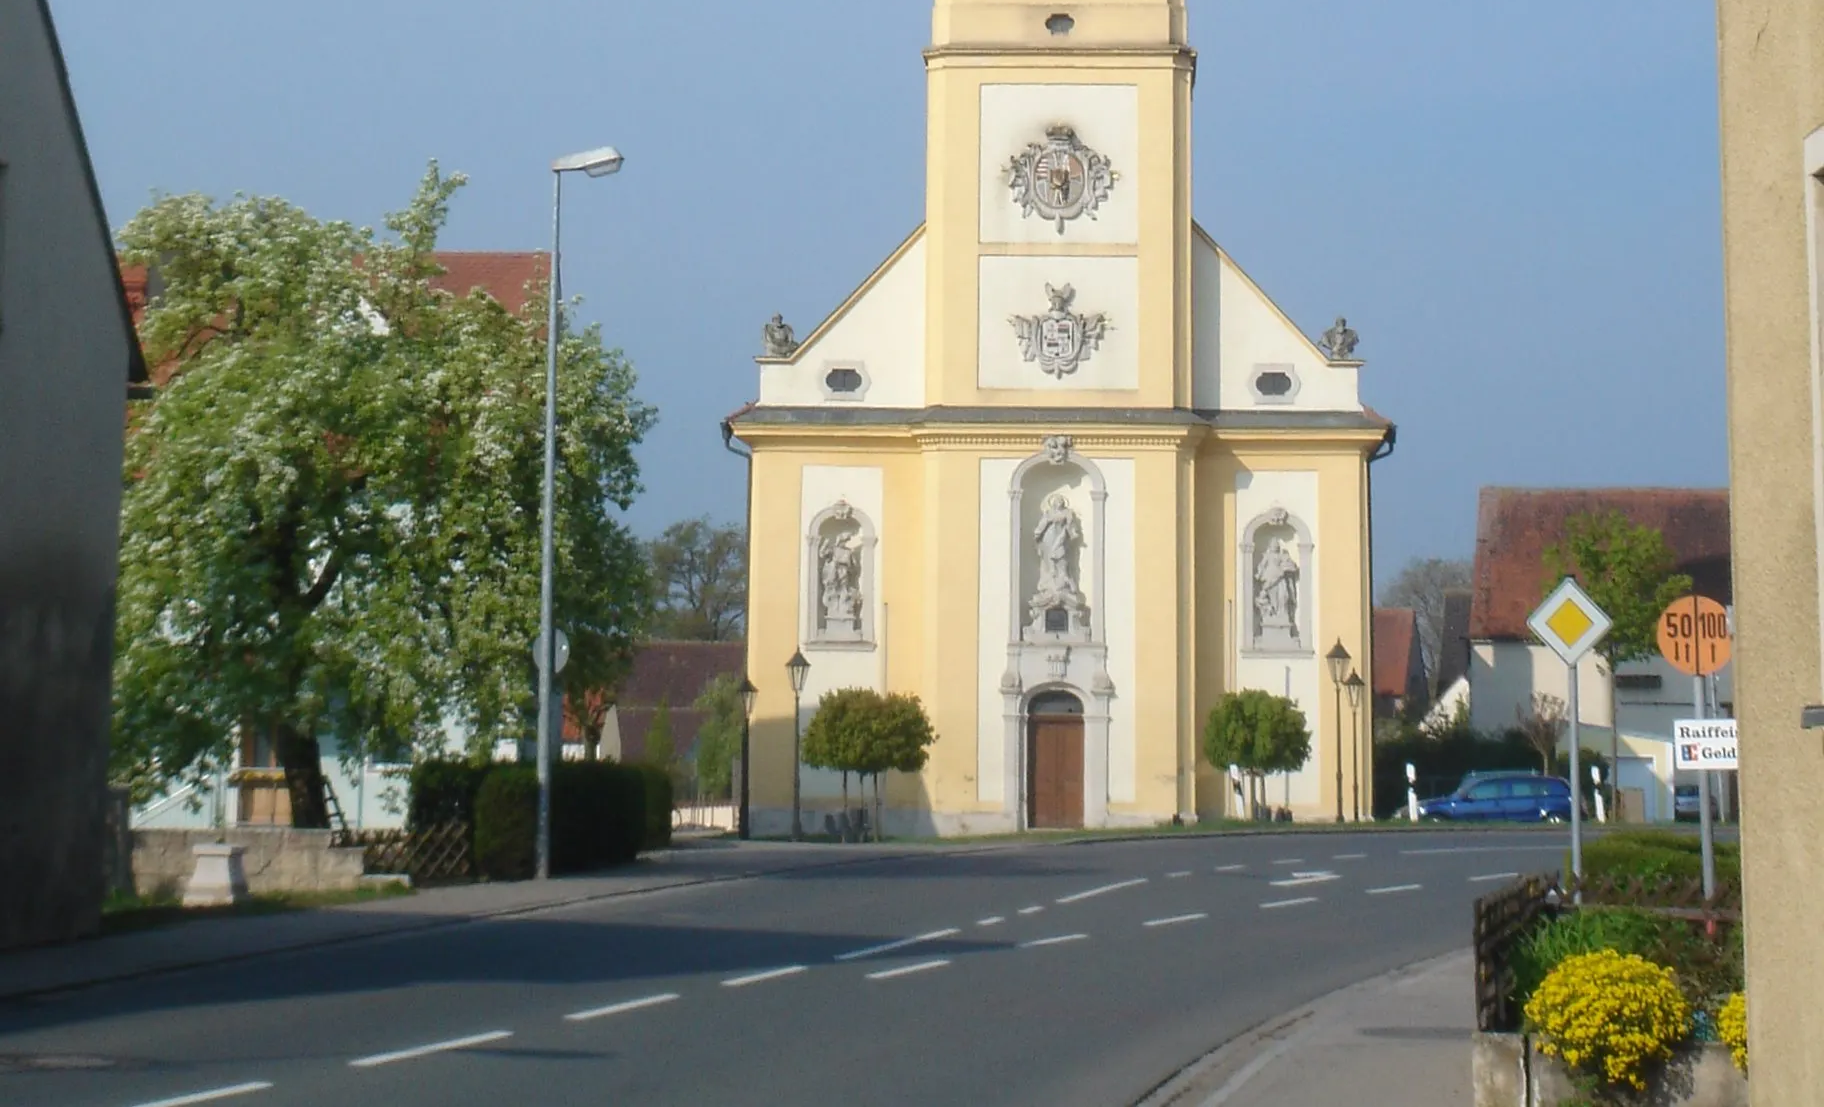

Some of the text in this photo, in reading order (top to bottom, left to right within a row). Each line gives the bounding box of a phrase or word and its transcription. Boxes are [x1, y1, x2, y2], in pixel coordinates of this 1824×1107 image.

[1666, 612, 1727, 639] 50 100
[1702, 746, 1737, 759] Geld
